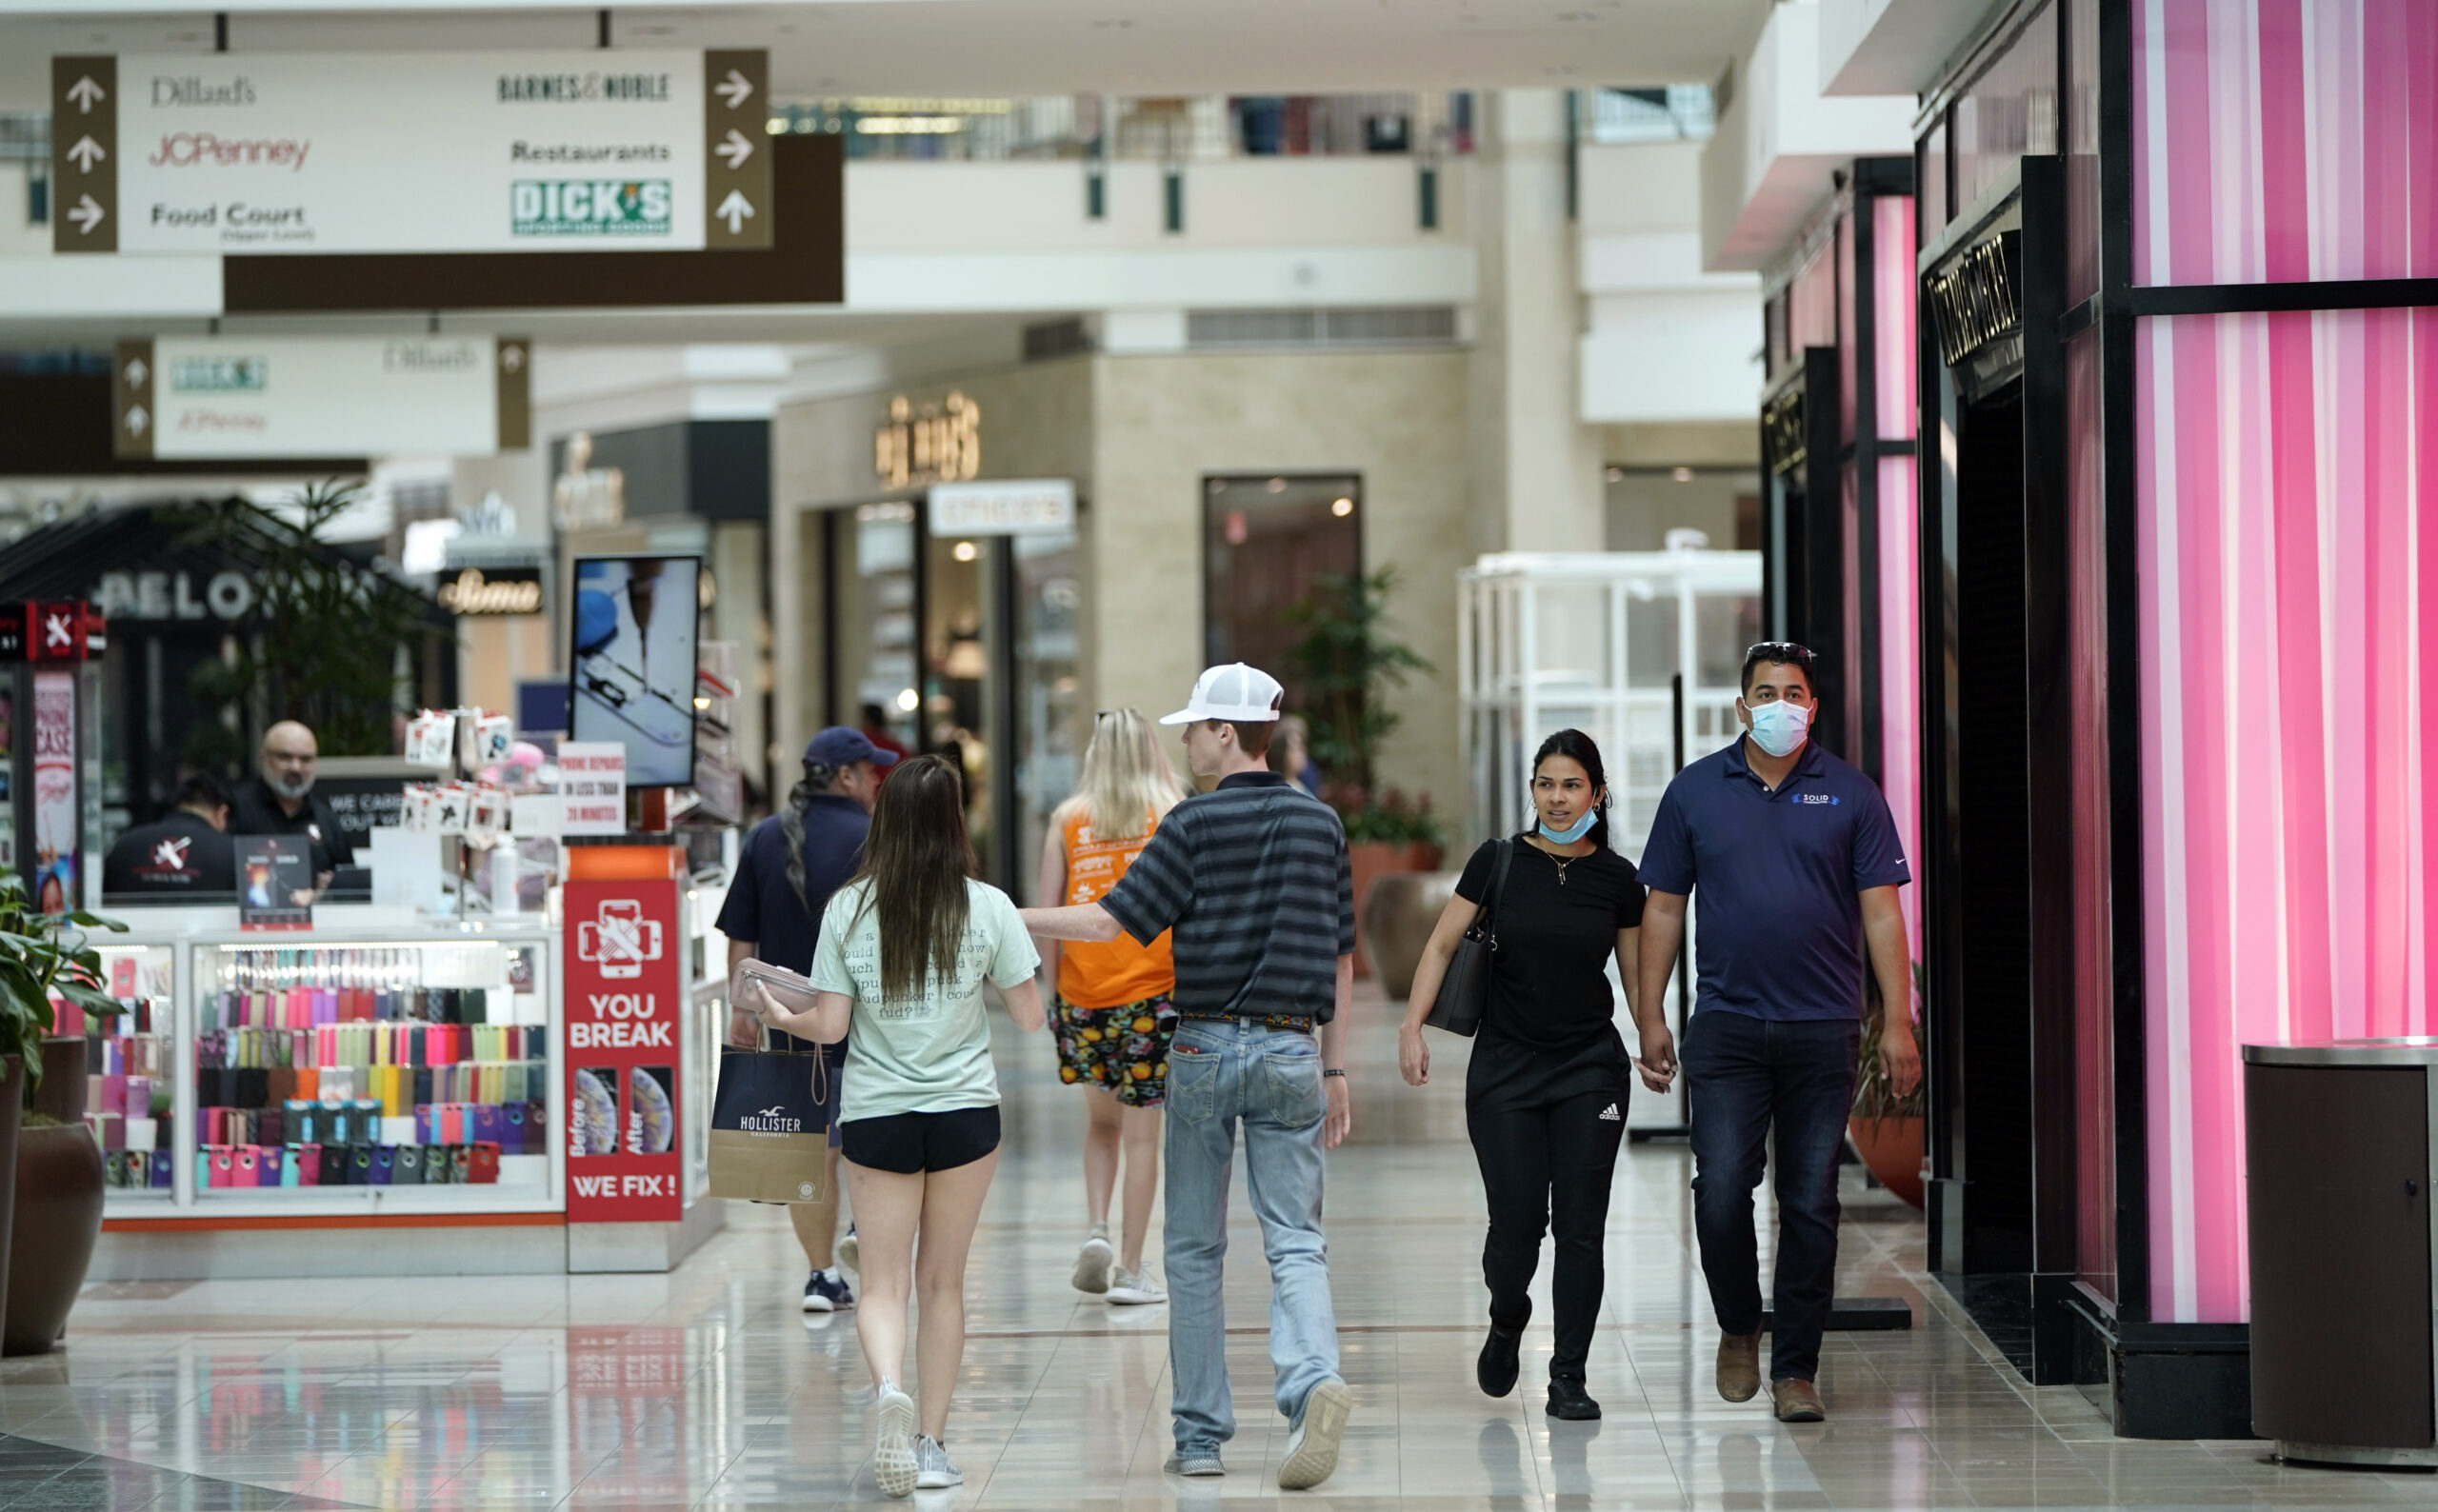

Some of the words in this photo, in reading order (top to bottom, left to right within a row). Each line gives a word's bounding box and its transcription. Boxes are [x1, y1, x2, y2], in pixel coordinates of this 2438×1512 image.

[151, 76, 257, 107] Dillard's
[149, 132, 311, 172] JCPenney
[511, 141, 670, 161] Restaurants
[514, 181, 669, 222] DICK'S
[151, 203, 217, 227] Food
[226, 202, 306, 227] Court
[329, 794, 357, 812] WE
[339, 813, 376, 831] OUT
[866, 932, 874, 942] a
[848, 963, 873, 974] uch
[926, 958, 966, 970] cod
[928, 976, 963, 987] puck
[588, 993, 656, 1020] YOU
[947, 991, 974, 1000] cou
[879, 1006, 912, 1018] fud?
[570, 1021, 673, 1048] BREAK
[569, 1098, 587, 1158] Before
[626, 1110, 644, 1156] After
[740, 1116, 801, 1132] HOLLISTER
[572, 1176, 618, 1198] WE
[622, 1174, 664, 1198] FIX
